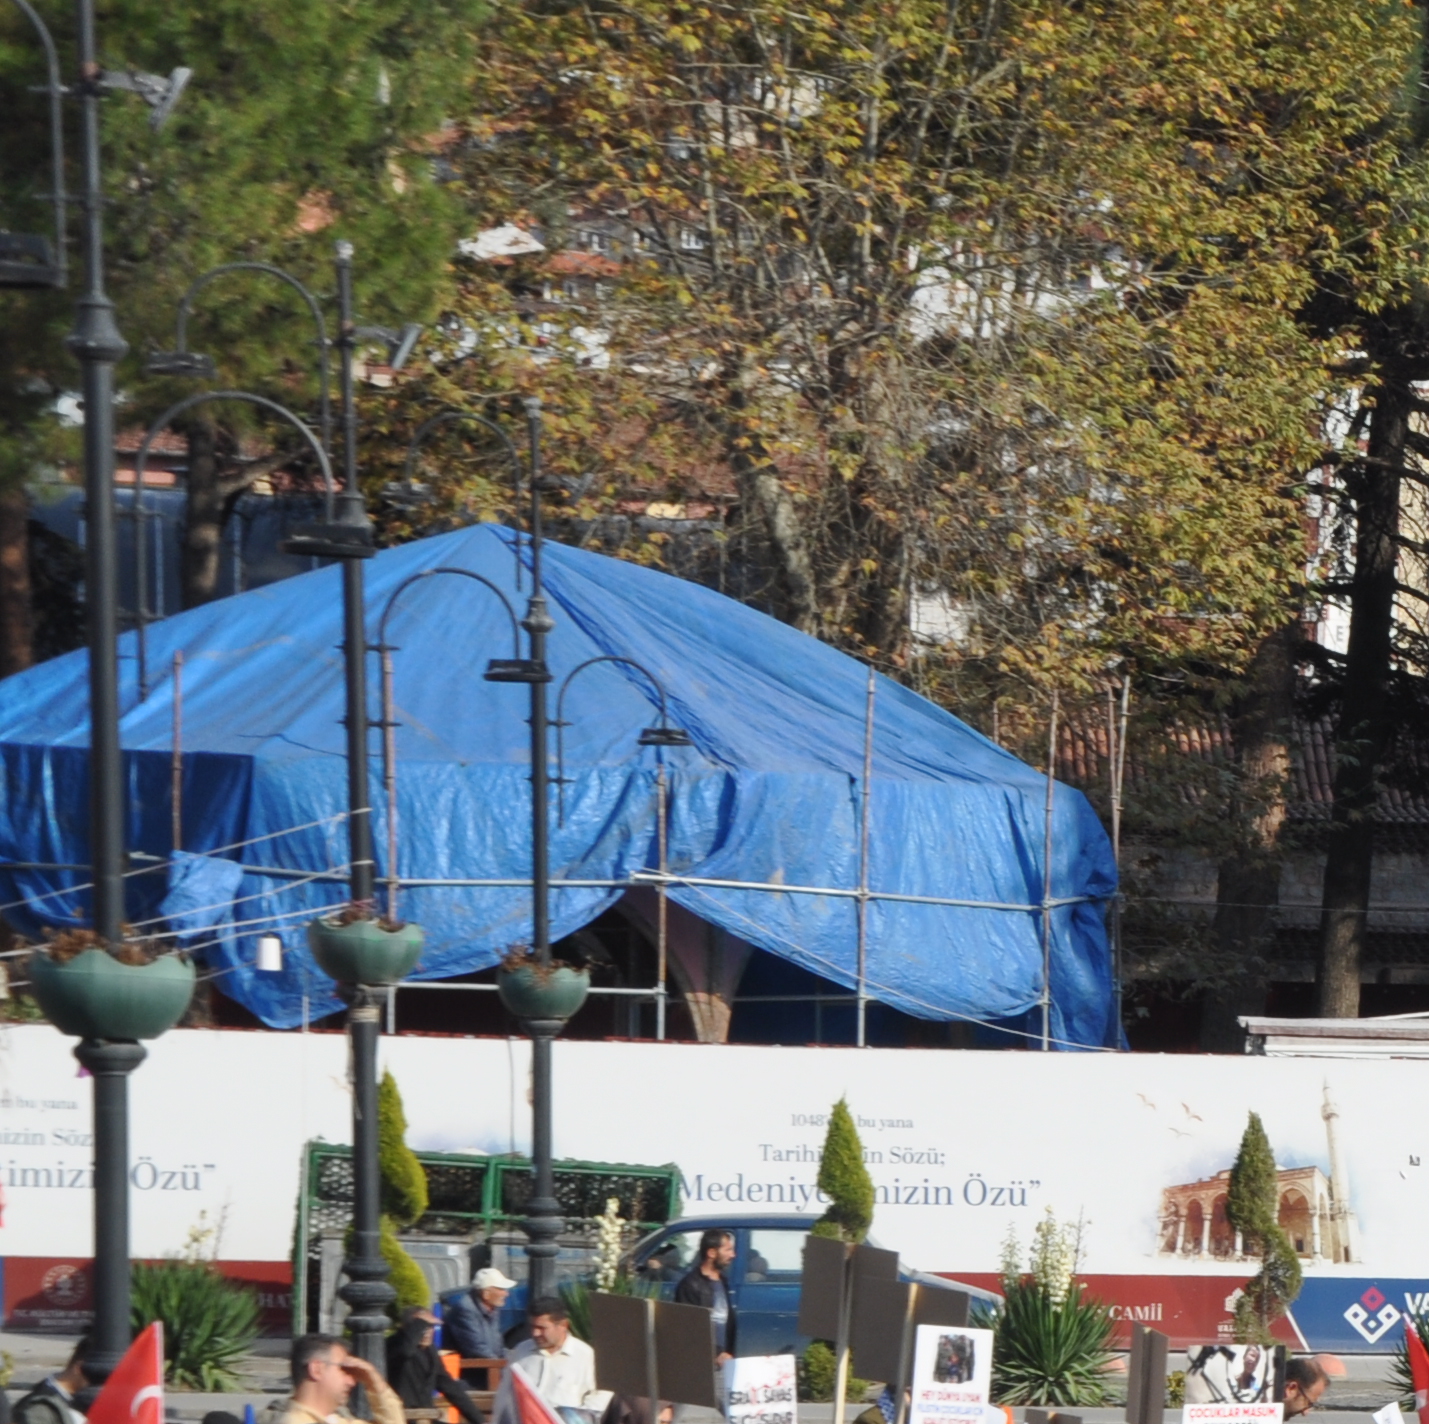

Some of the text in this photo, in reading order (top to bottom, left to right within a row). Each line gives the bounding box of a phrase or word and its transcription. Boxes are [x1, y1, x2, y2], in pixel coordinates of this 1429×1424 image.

[857, 1113, 877, 1129] bu
[878, 1117, 915, 1132] yana
[888, 1146, 946, 1167] Sözü;
